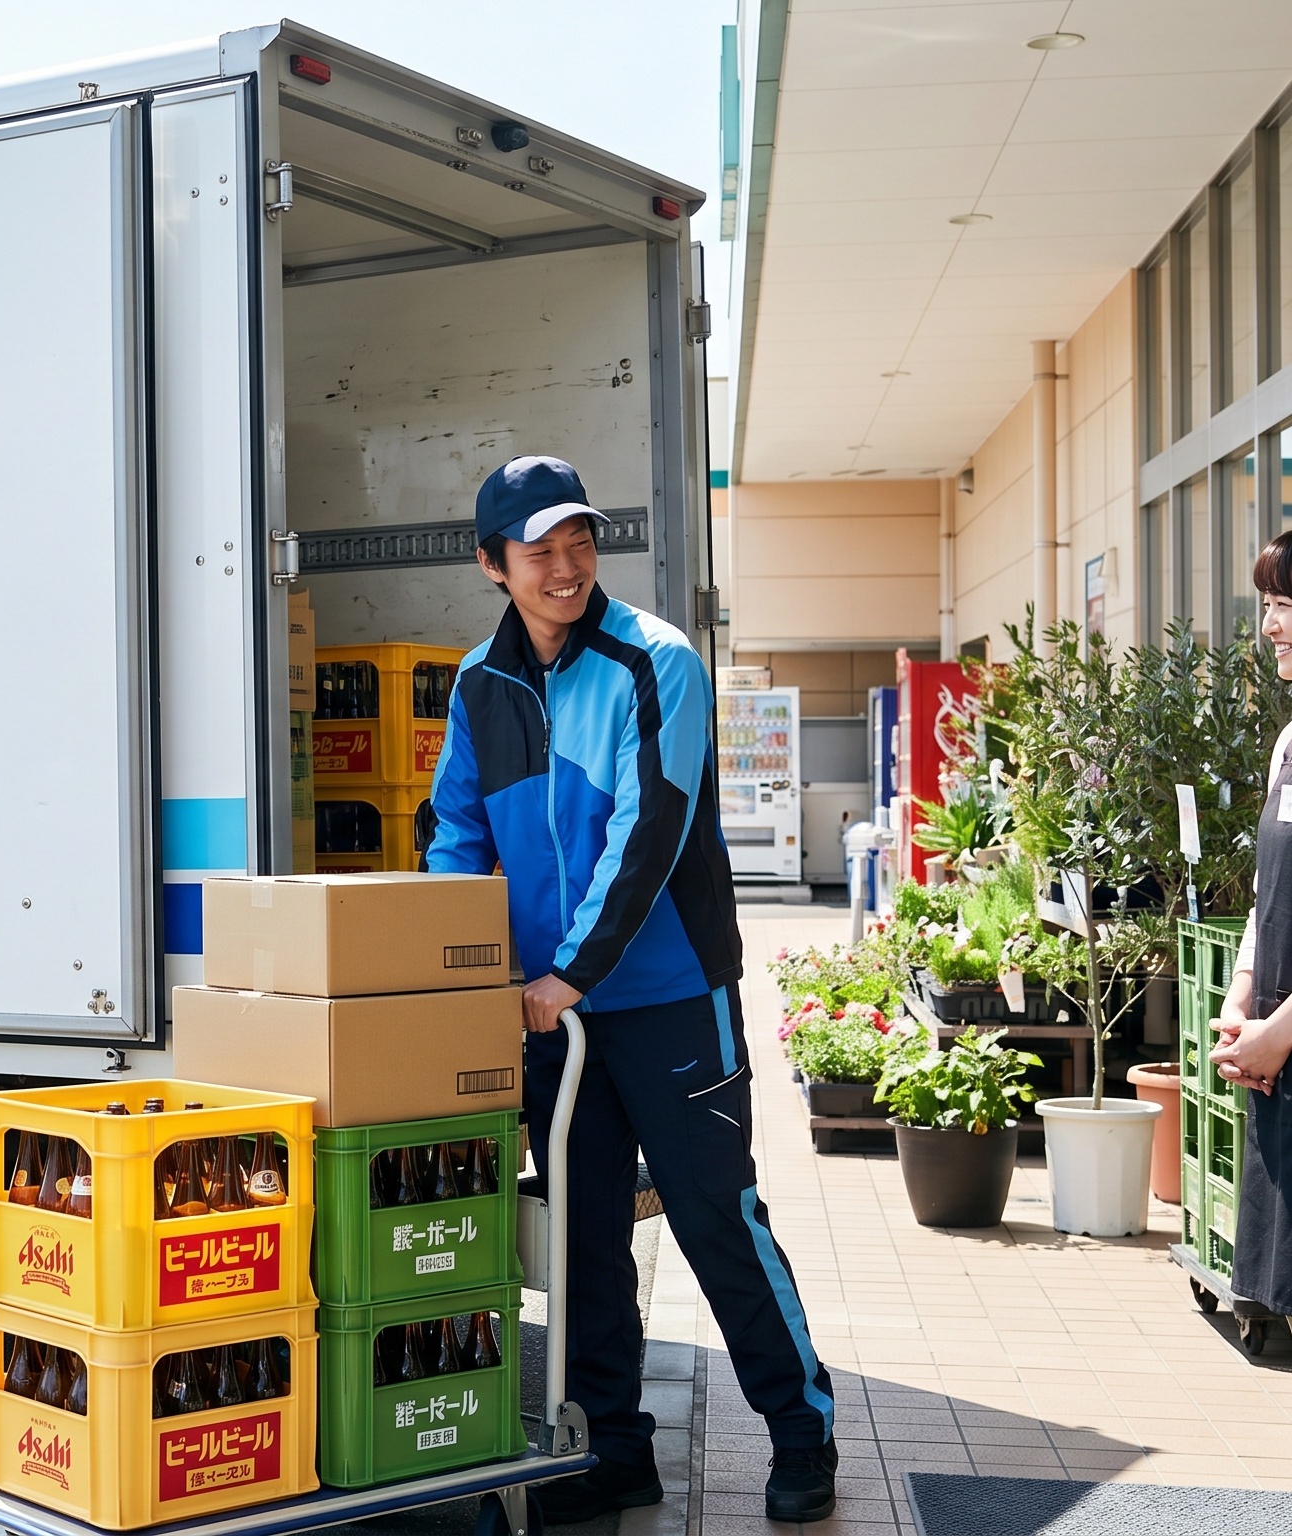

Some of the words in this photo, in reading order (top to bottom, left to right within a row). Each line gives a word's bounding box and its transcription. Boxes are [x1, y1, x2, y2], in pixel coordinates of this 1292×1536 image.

[18, 1234, 74, 1277] Asahi
[166, 1231, 275, 1273] ビールビール
[18, 1425, 71, 1470] Asahi
[166, 1421, 275, 1467] ビールビール
